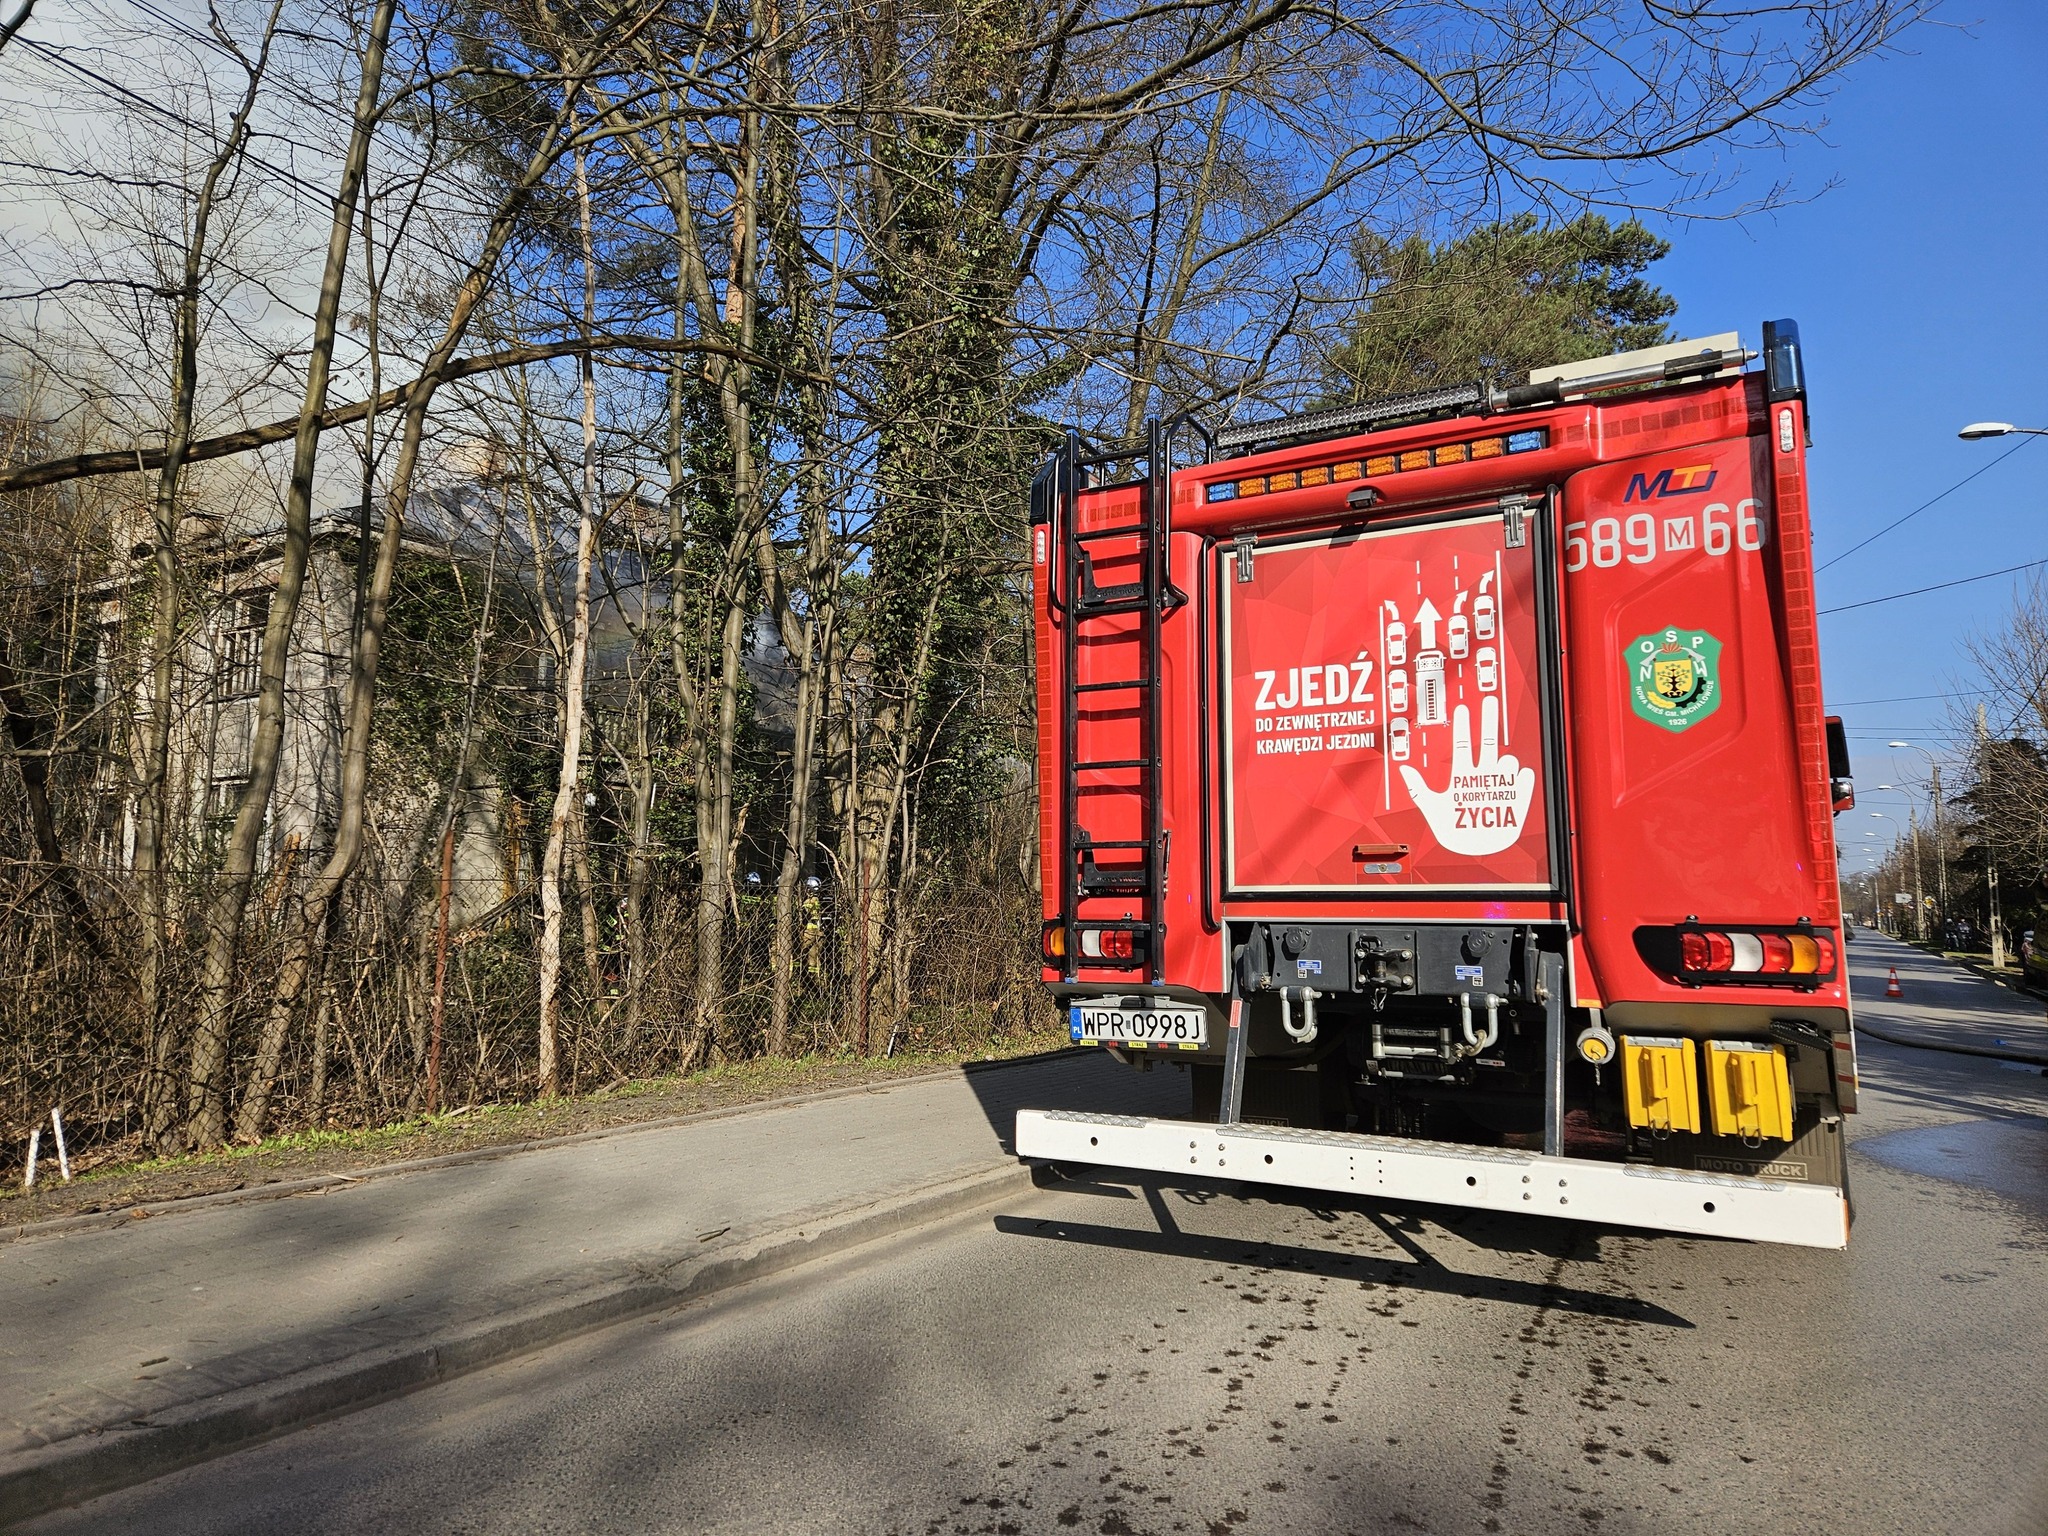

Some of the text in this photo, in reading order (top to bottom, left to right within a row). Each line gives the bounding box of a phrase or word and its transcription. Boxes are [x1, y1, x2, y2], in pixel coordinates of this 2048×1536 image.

[1703, 498, 1766, 556] 66
[1254, 651, 1375, 711] ZJEDŹ
[1255, 709, 1375, 733] DO ZEWNĘTRZNEJ
[1668, 718, 1688, 726] 1926
[1256, 732, 1375, 755] KRAWĘDZI JEZDNI
[1453, 773, 1515, 790] PAMIĘTAJ
[1453, 790, 1517, 803] O KORYTARZU
[1454, 801, 1518, 829] ŻYCIA
[1073, 1026, 1082, 1034] PL
[1083, 1012, 1125, 1037] WPR
[1132, 1013, 1201, 1040] 0998J
[1700, 1158, 1802, 1177] MOTO TRUCK
